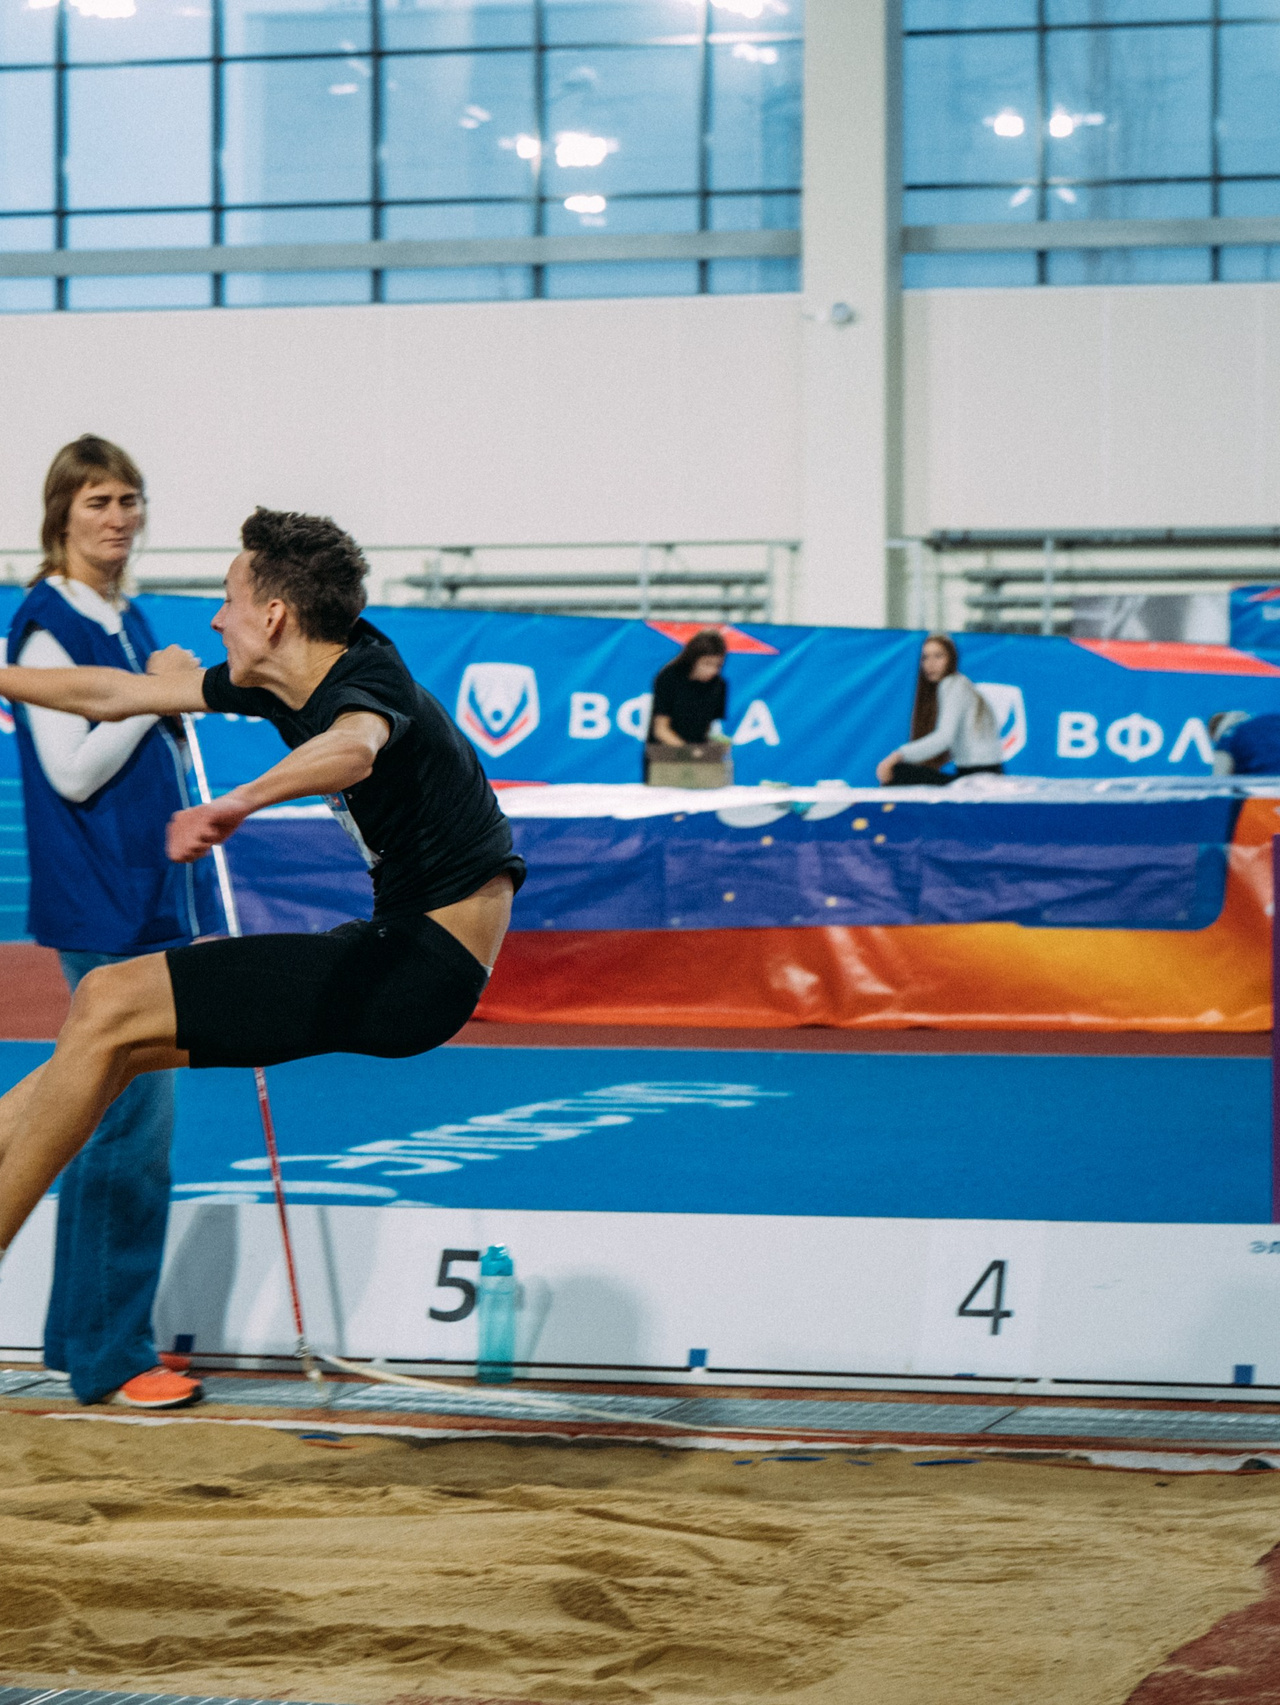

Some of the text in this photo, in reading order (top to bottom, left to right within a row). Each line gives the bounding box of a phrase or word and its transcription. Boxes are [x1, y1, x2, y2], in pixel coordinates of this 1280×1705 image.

[568, 691, 781, 747] ВФА
[1056, 710, 1215, 764] ВФЛ
[428, 1248, 480, 1322] 5
[956, 1259, 1013, 1336] 4
